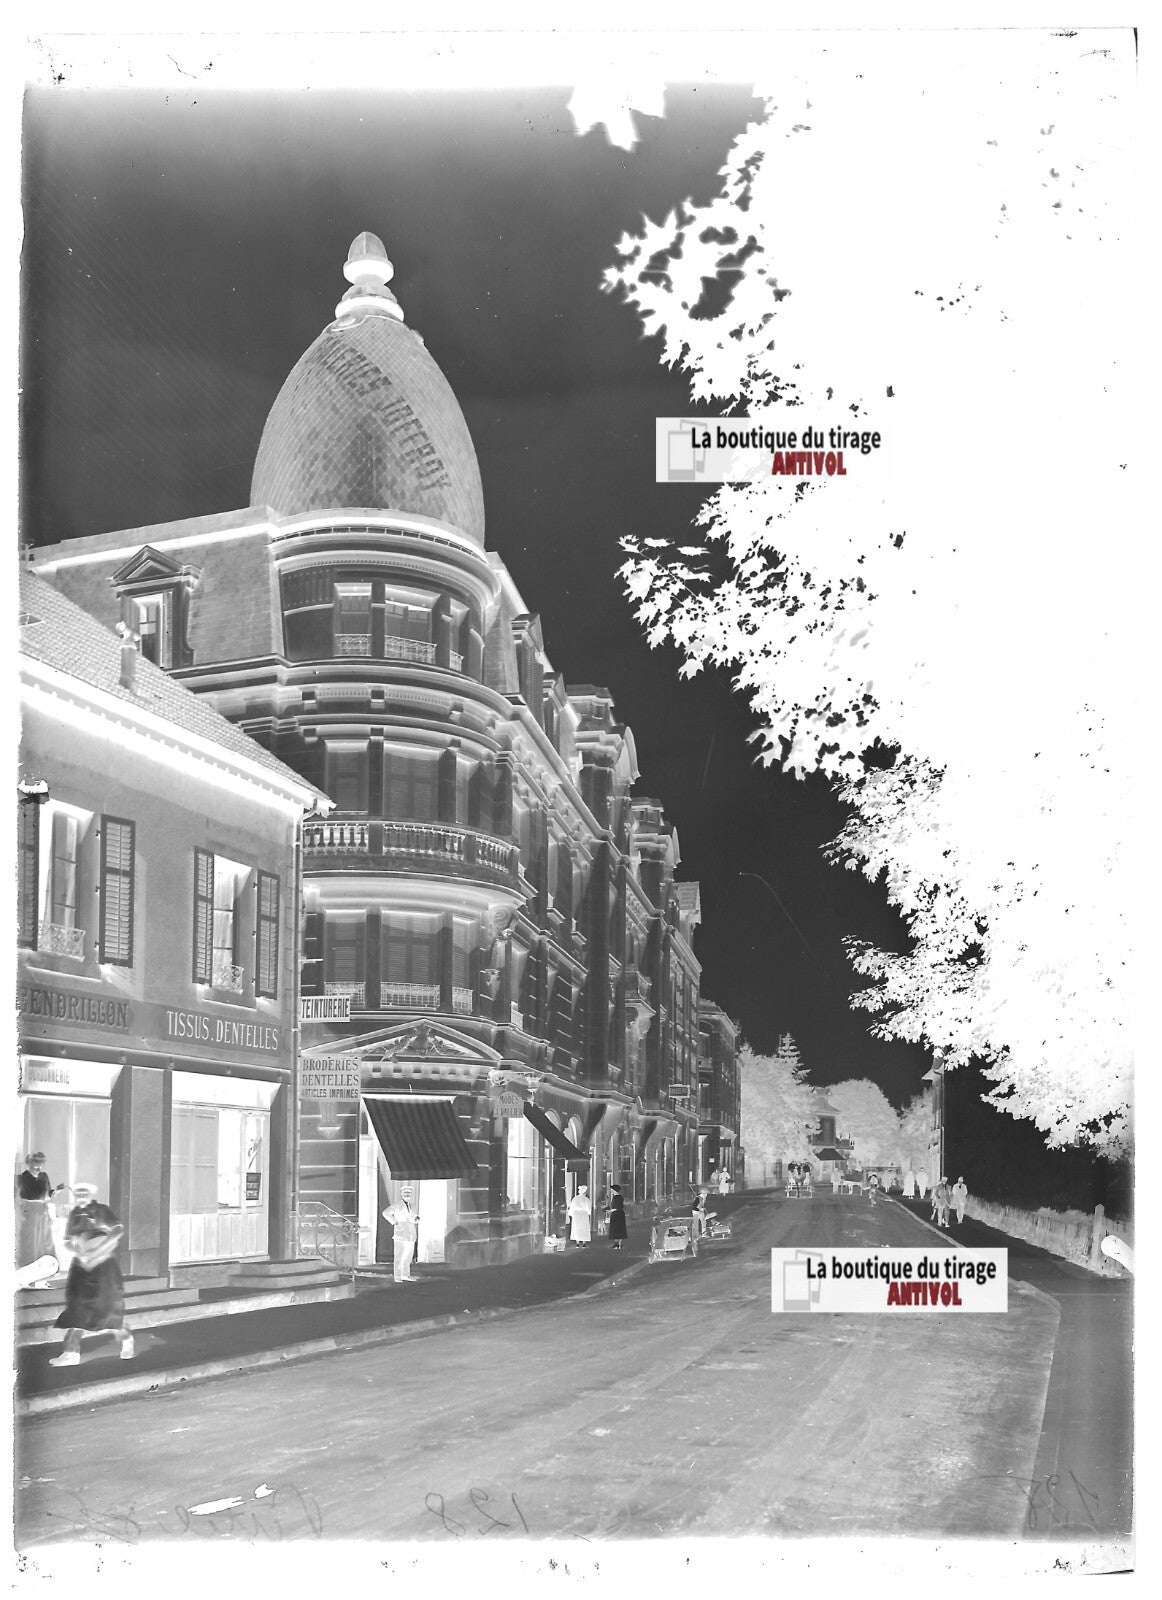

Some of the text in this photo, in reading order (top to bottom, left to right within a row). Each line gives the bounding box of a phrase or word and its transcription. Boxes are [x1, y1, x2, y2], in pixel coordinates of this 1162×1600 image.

[374, 396, 451, 492] JOFFROY
[301, 998, 350, 1019] TEINTURERIE
[216, 1020, 279, 1051] DENTELLES
[302, 1059, 359, 1072] BRODERIES
[302, 1074, 359, 1087] DENTELLES
[301, 1088, 327, 1098] ARTICLES
